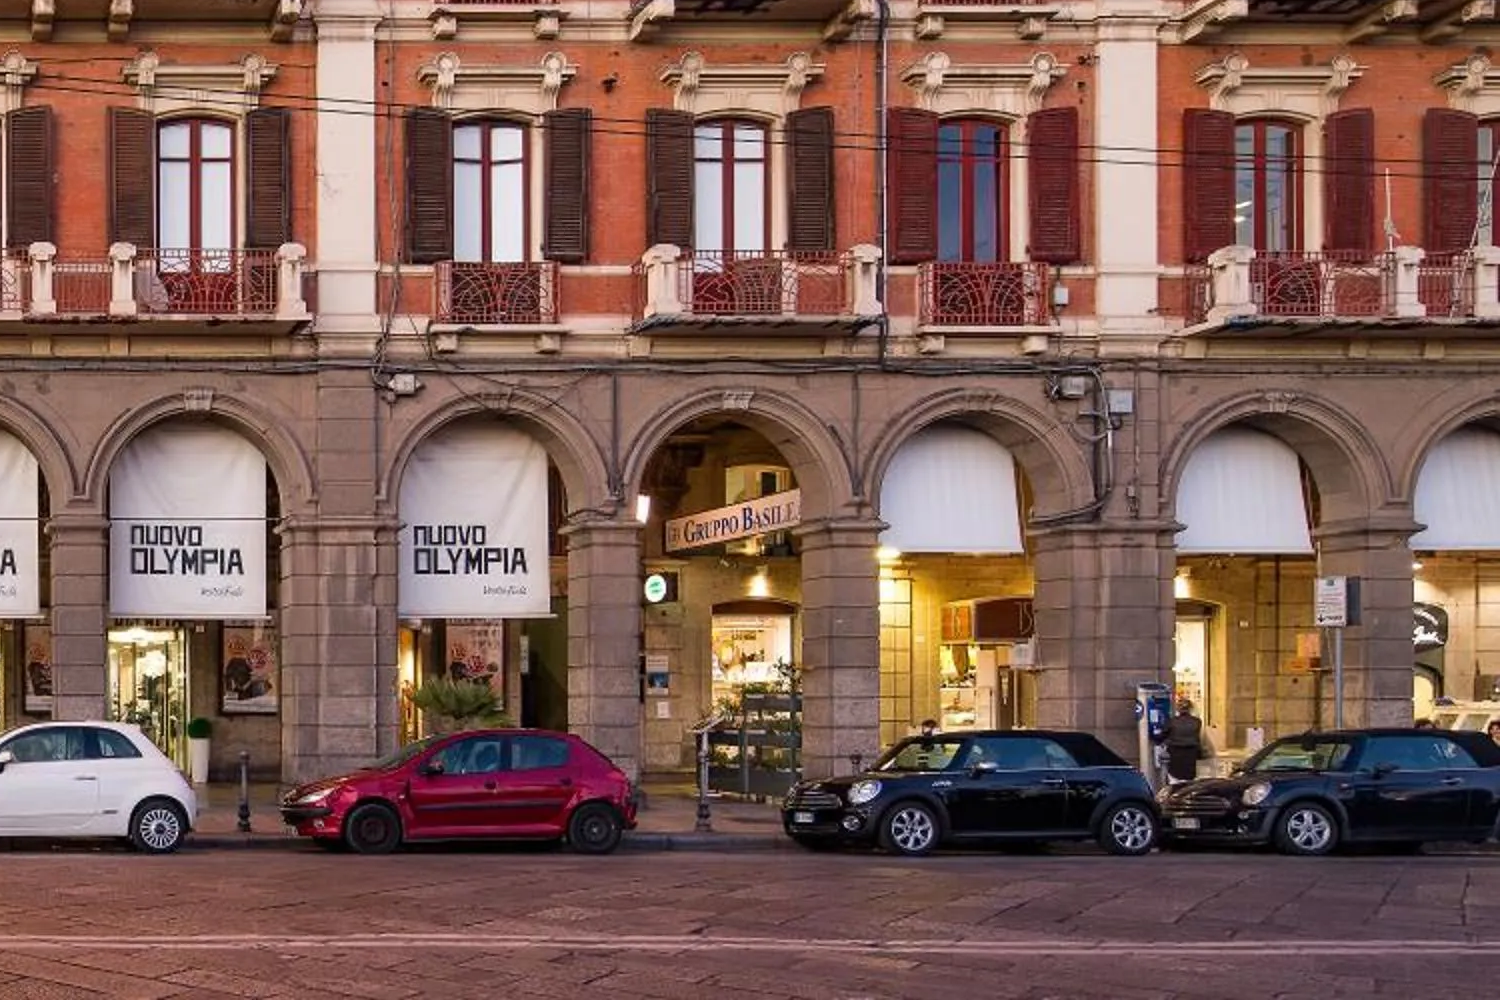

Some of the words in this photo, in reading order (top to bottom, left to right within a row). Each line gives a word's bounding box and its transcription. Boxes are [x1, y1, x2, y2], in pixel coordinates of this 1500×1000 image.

[684, 515, 739, 543] GRUPPO
[131, 548, 244, 575] OLYMPIA
[414, 547, 528, 575] OLYMPIA
